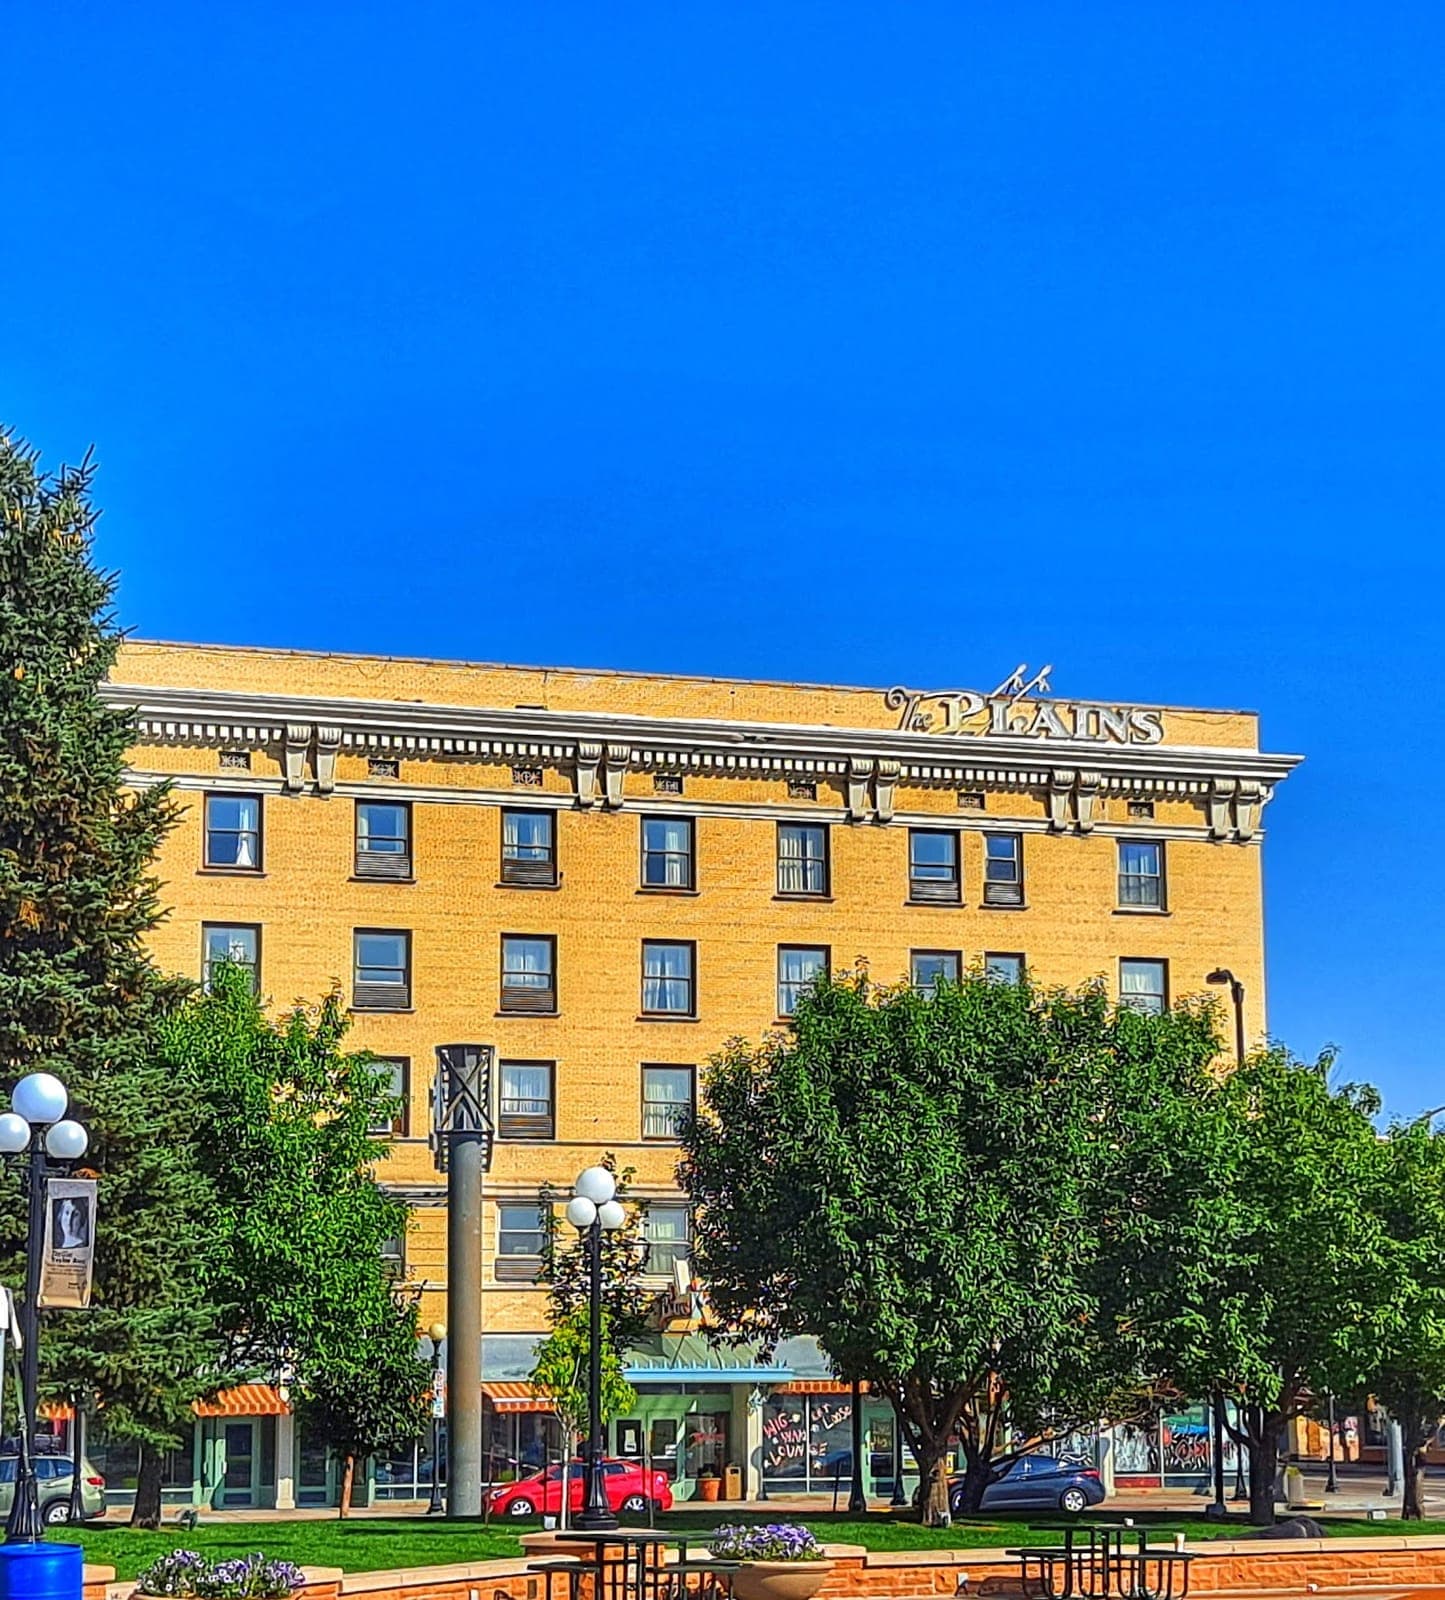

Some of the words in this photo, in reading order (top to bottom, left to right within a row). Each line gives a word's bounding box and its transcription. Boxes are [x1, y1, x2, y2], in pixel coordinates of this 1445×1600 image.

[885, 686, 934, 733] The
[922, 690, 1165, 745] PLAINS
[769, 1442, 828, 1466] LOUNGE
